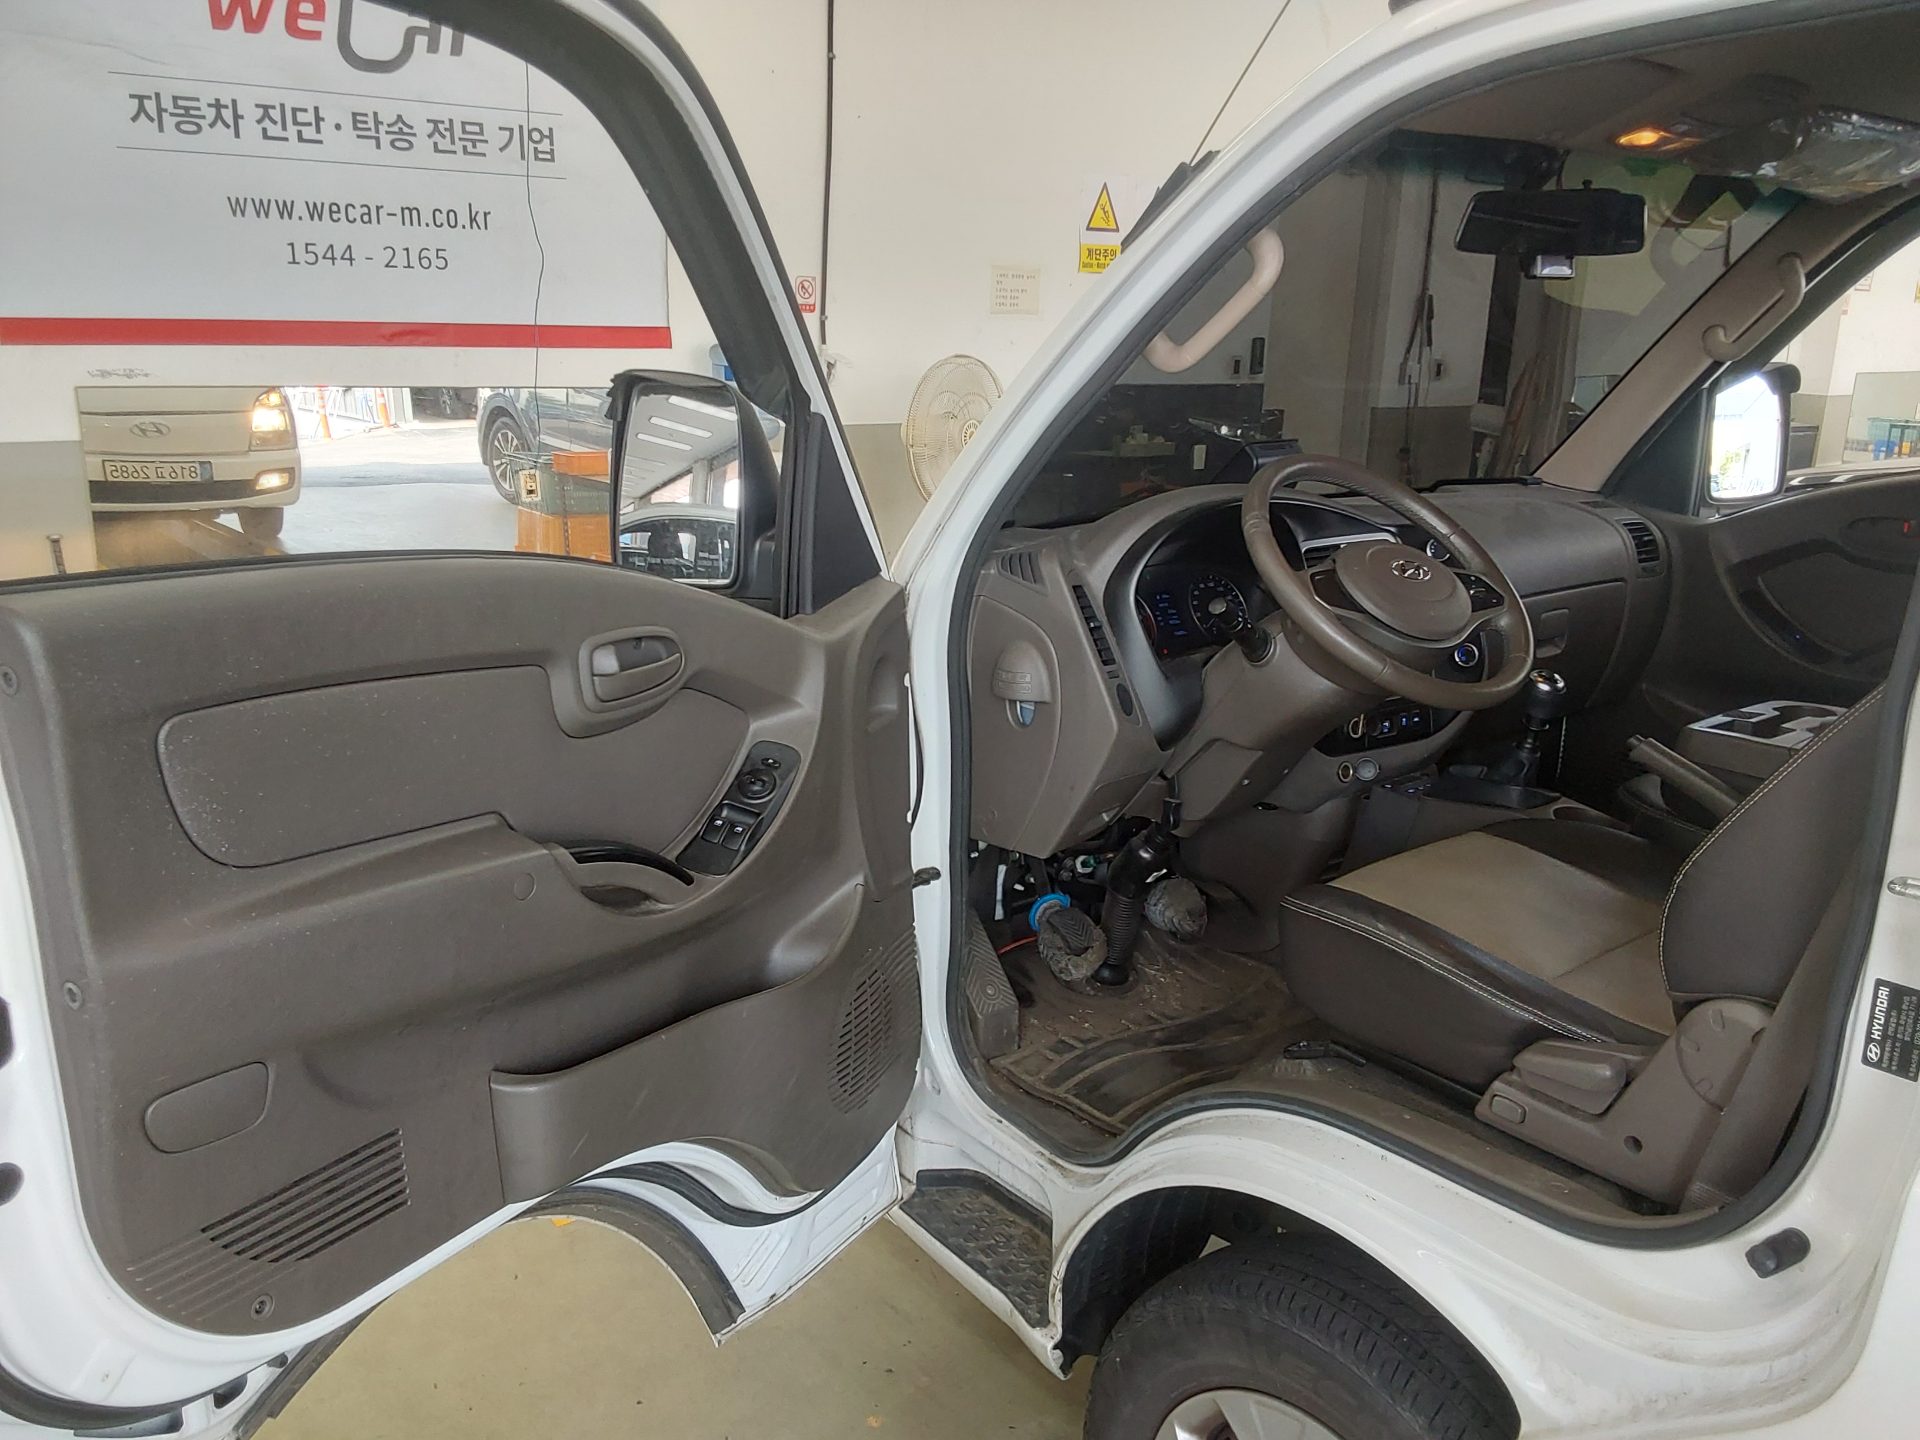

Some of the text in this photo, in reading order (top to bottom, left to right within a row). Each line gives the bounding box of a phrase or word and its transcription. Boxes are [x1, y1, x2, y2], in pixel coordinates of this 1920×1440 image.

[128, 91, 245, 139] 자동차
[254, 102, 326, 145] 진단
[351, 111, 417, 151] 탁송
[426, 117, 489, 158] 전문
[498, 123, 556, 163] 기업
[226, 196, 492, 231] www.wecar-m.co.kr
[286, 242, 356, 267] 1544
[382, 246, 449, 271] 2165
[1086, 247, 1117, 261] 계단주의
[1870, 986, 1890, 1040] HYUNDAI
